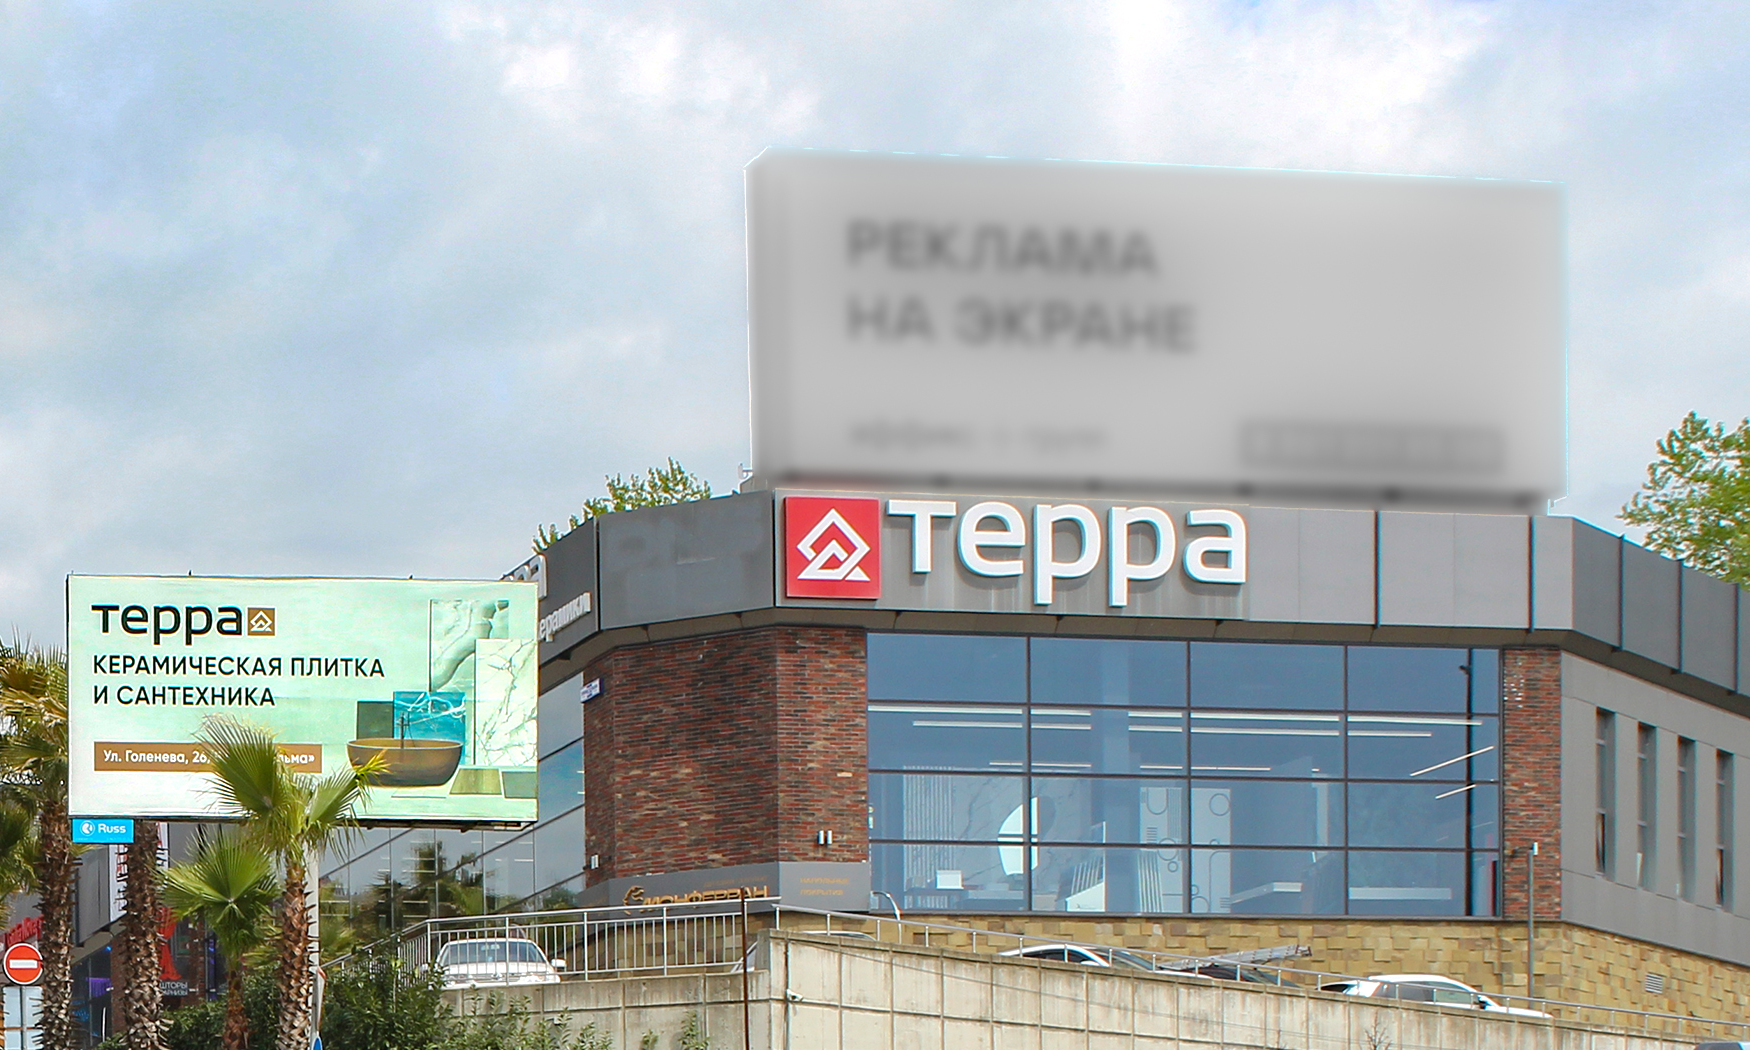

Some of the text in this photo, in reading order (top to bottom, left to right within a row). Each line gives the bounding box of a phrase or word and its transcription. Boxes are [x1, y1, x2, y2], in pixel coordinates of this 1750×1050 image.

[846, 220, 1159, 276] РЕКЛАМА
[846, 296, 1198, 352] НА ЭКРАНЕ
[888, 500, 1246, 608] терра
[91, 604, 244, 645] терра
[93, 656, 385, 679] КЕРАМИЧЕСКАЯ ПЛИТКА
[93, 686, 275, 707] И САНТЕХНИКА
[103, 750, 122, 762] Ул.
[125, 751, 188, 764] Голенева,
[98, 823, 126, 833] Russ
[159, 981, 188, 989] ШТОРЫ
[161, 988, 188, 996] АРНИЗЫ
